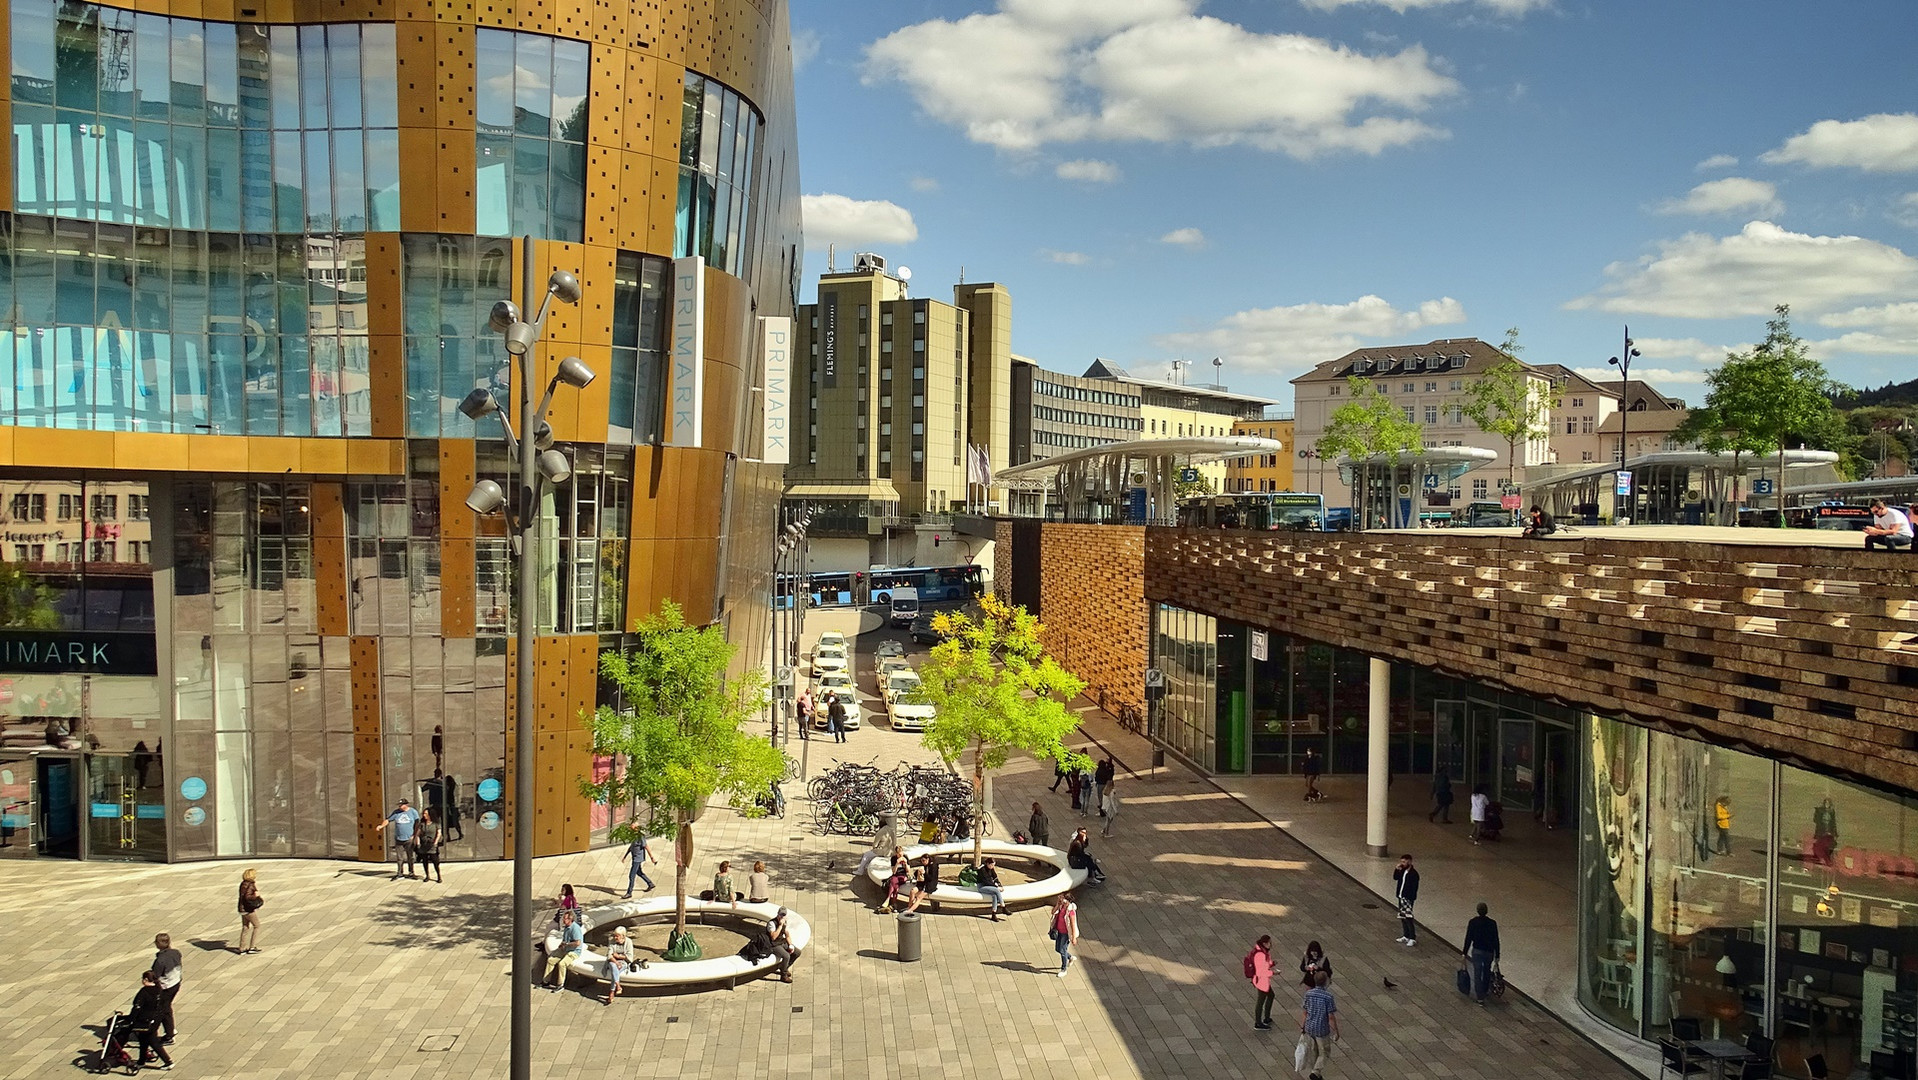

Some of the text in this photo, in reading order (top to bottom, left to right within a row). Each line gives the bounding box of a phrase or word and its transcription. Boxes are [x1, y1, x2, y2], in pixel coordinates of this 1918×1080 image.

[676, 275, 694, 428] PRIMARK
[826, 331, 834, 375] FLEMING'S
[768, 331, 786, 449] PRIMARK
[1186, 470, 1195, 481] 5
[1427, 475, 1436, 487] 4
[1760, 481, 1769, 493] 3
[6, 641, 110, 664] IMARK
